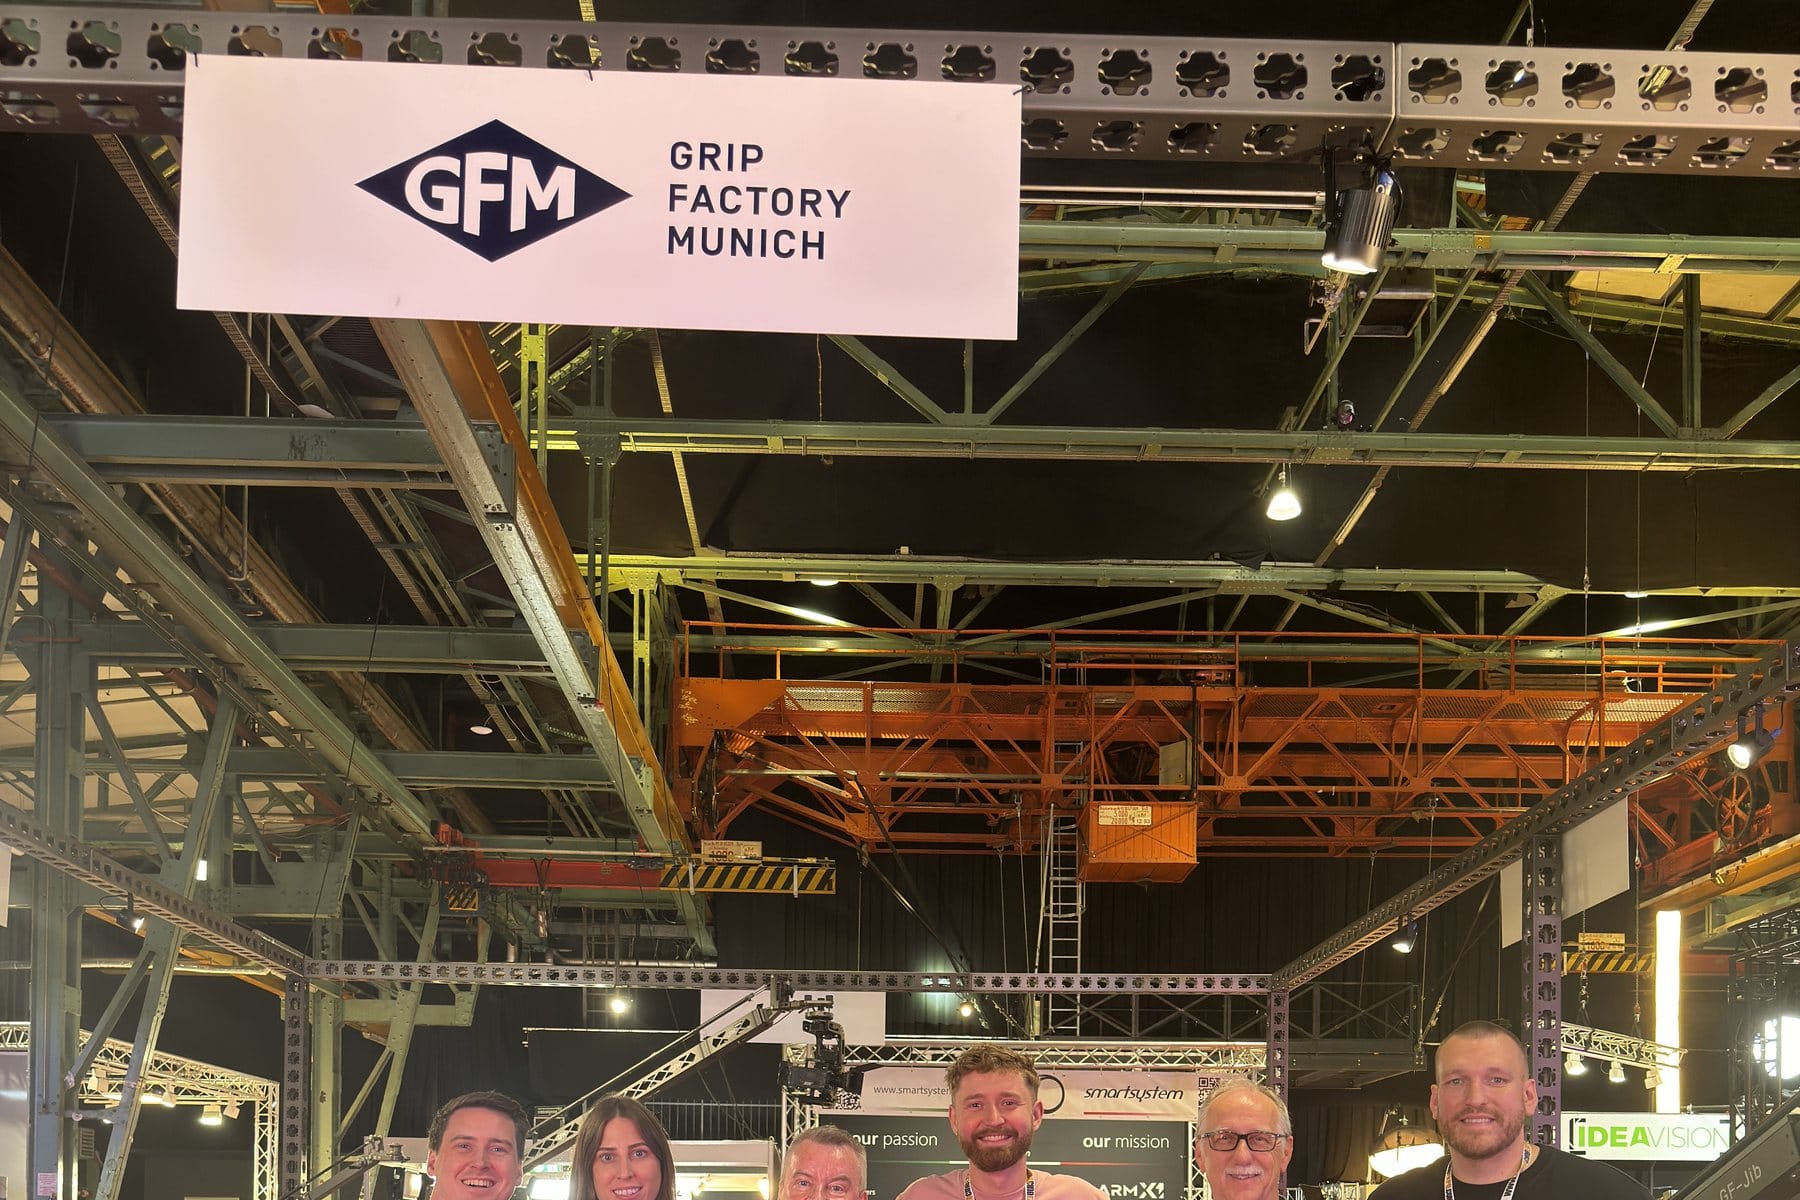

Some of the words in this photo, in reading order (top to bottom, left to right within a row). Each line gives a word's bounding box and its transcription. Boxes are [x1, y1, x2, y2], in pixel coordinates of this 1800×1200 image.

[669, 141, 764, 172] GRIP
[405, 151, 576, 236] GFM
[668, 183, 852, 219] FACTORY
[667, 226, 826, 260] MUNICH
[1084, 1086, 1184, 1103] smartsystem
[883, 1132, 938, 1149] passion
[1083, 1136, 1111, 1149] our
[1115, 1134, 1170, 1149] mission
[1578, 1126, 1730, 1148] IDEAVISION
